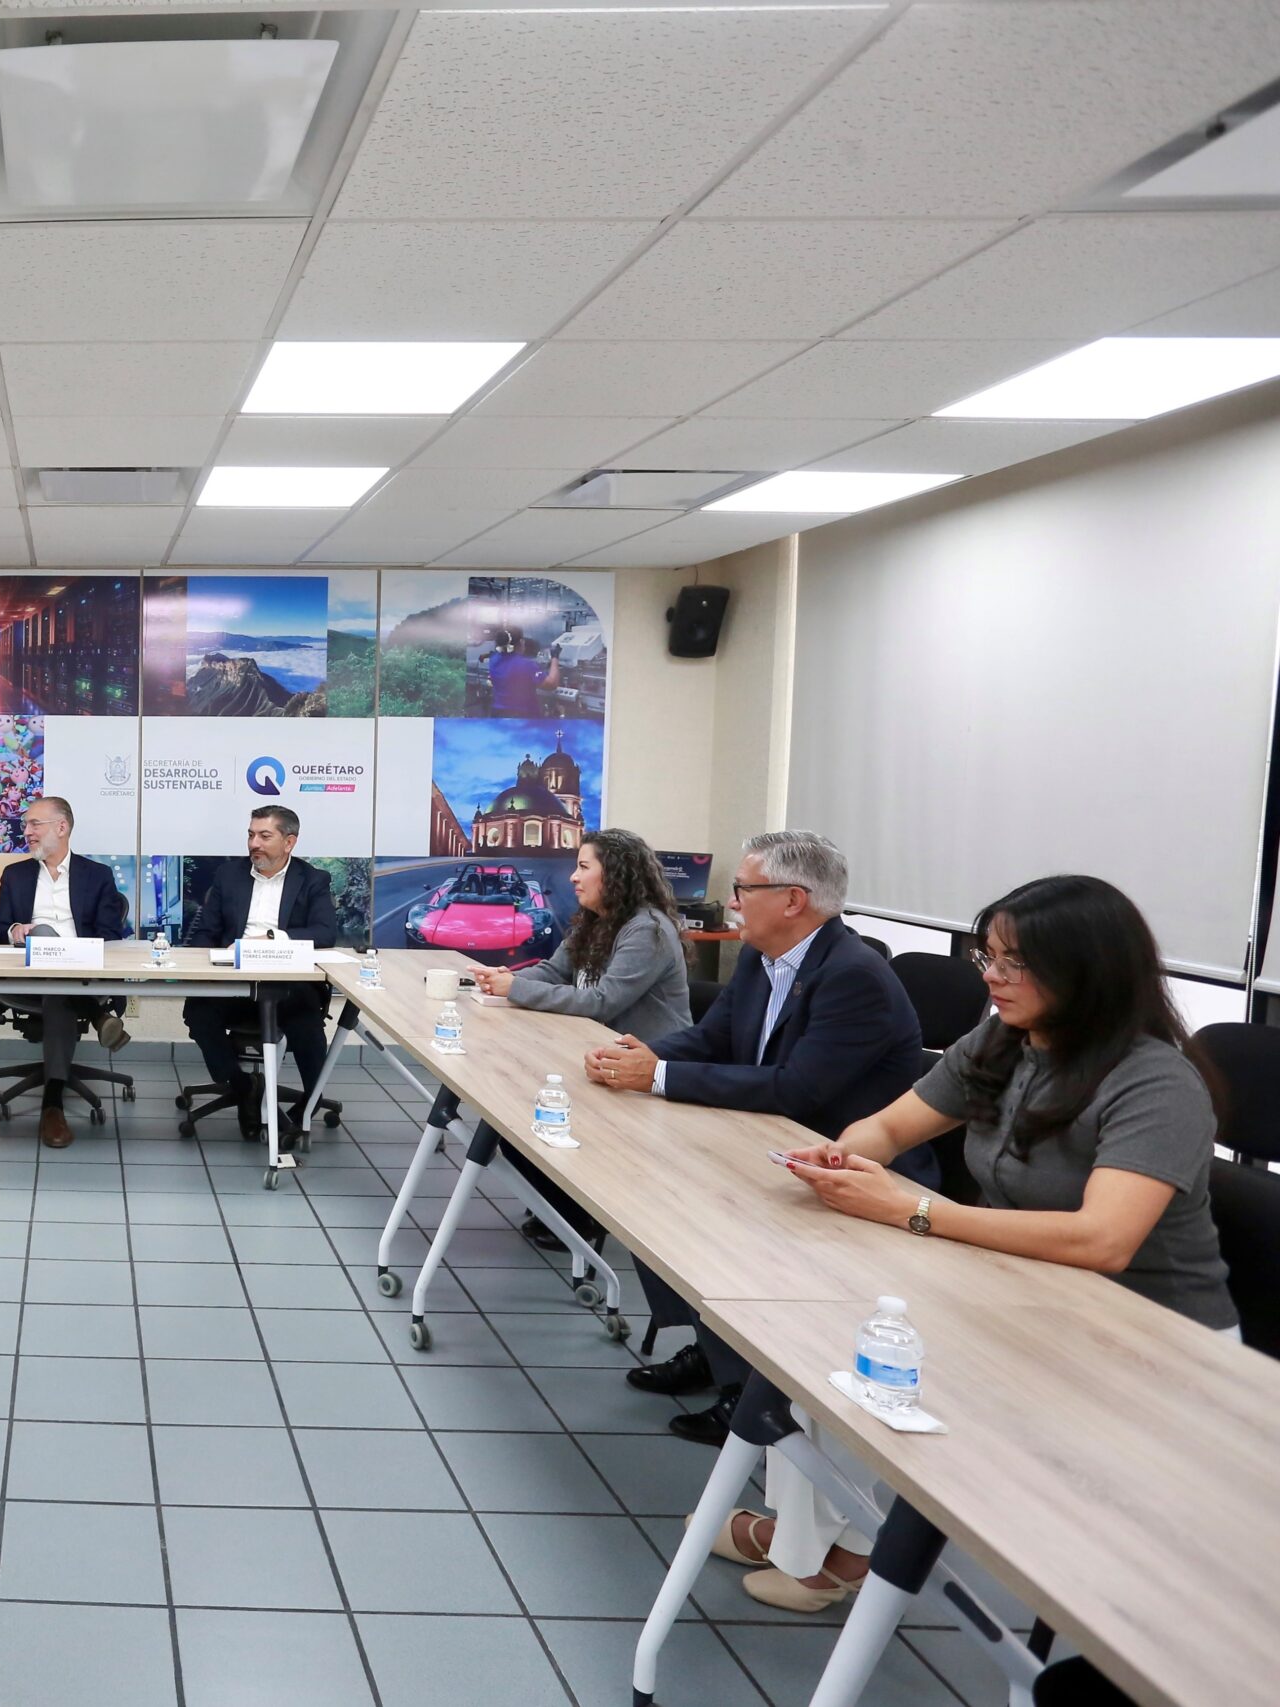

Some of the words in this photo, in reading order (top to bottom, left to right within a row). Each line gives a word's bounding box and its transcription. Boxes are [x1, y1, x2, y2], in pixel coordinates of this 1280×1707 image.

[143, 759, 190, 767] SECRETARÍA
[144, 768, 219, 778] DESARROLLO
[291, 762, 364, 775] QUERÉTARO
[143, 780, 223, 790] SUSTENTABLE
